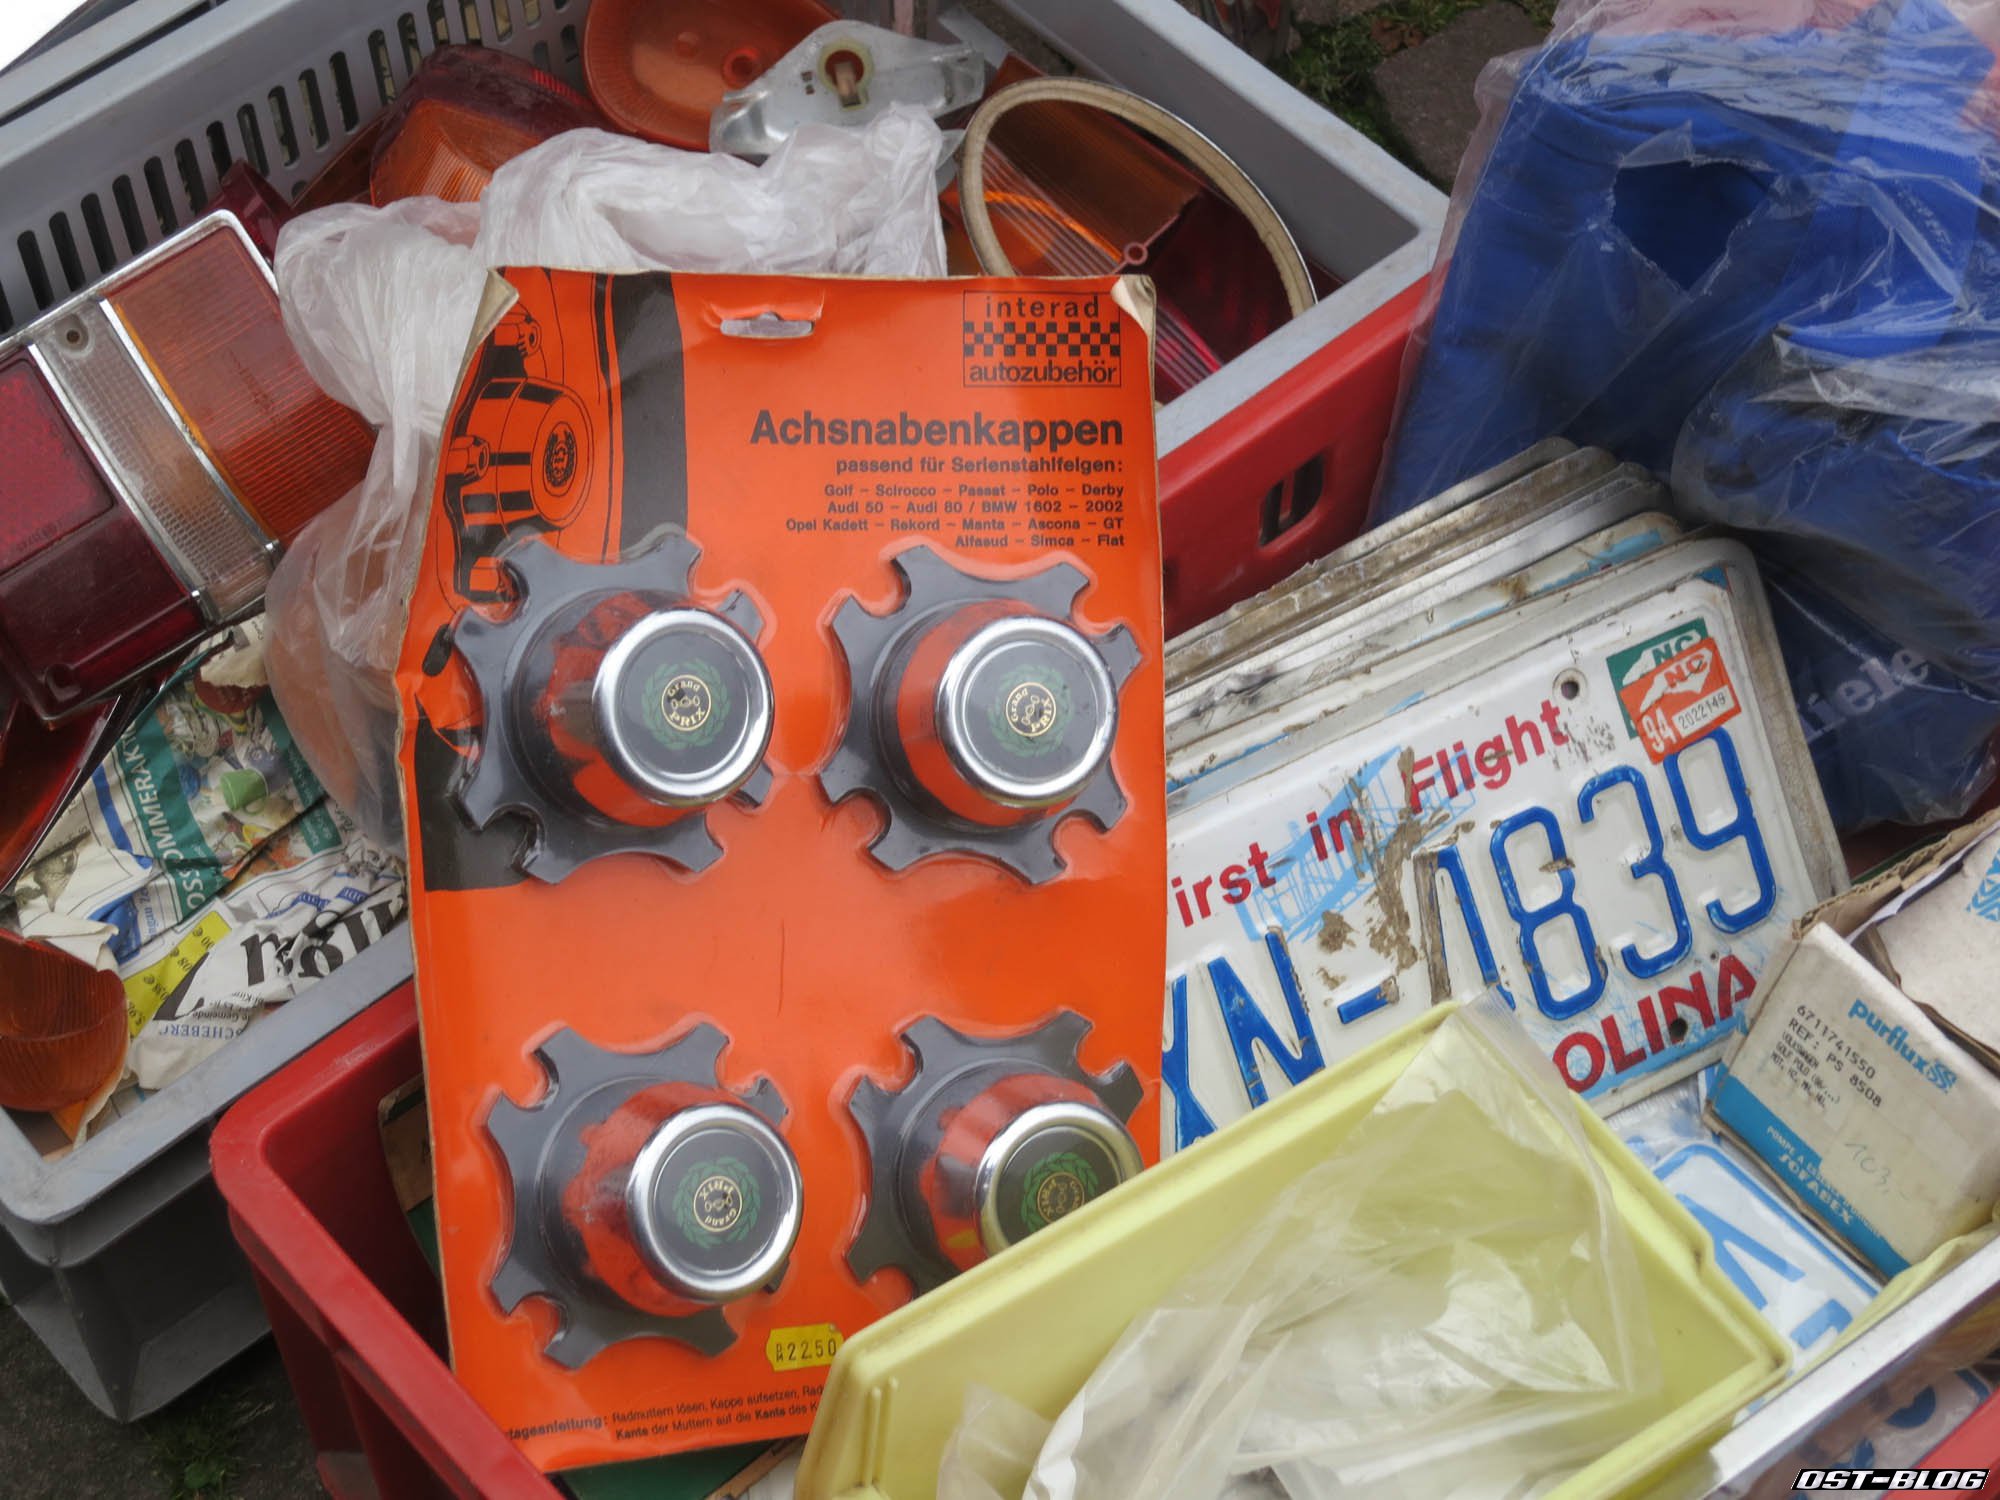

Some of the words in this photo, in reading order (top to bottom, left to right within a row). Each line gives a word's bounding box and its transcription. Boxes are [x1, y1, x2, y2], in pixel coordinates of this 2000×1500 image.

[985, 295, 1100, 318] interad
[969, 359, 1117, 383] autozubehör
[750, 409, 1123, 453] Achsnabenkappen
[836, 456, 913, 475] passend
[920, 455, 945, 473] für
[952, 456, 1123, 476] Serienstahlfelgen:
[824, 484, 853, 497] Golf
[875, 484, 937, 497] Scirocco
[958, 484, 1006, 497] Passat
[1027, 483, 1059, 496] Polo
[1081, 483, 1124, 498] Derby
[827, 501, 859, 514] Audi
[865, 502, 884, 514] 50
[906, 501, 938, 513] Audi
[944, 501, 962, 513] 80
[981, 501, 1018, 513] BMW
[1026, 501, 1062, 513] 1602
[1085, 500, 1123, 513] 2002
[786, 518, 817, 533] Opel
[822, 518, 869, 531] Kadett
[890, 518, 941, 531] Rekord
[962, 518, 1006, 531] Manta
[1028, 518, 1081, 530] Ascona
[1103, 517, 1123, 530] GT
[955, 535, 1008, 548] Alfasud
[1030, 535, 1075, 547] Simca
[1097, 534, 1125, 547] Fiat
[1663, 653, 1708, 689] NC
[1796, 649, 1929, 743] iele
[669, 706, 706, 727] PRIX
[1306, 805, 1366, 864] in
[1401, 698, 1571, 813] Flight
[1796, 1004, 1877, 1080] 6711741550
[1848, 997, 1931, 1076] purflux
[1826, 1053, 1845, 1073] PS
[1848, 1074, 1883, 1108] 8508
[612, 1405, 674, 1423] Radmuttern
[710, 1396, 743, 1410] Kappe
[615, 1426, 649, 1441] Kante
[651, 1422, 669, 1435] der
[672, 1416, 713, 1432] Muttern
[716, 1413, 732, 1425] auf
[736, 1411, 751, 1423] die
[755, 1406, 786, 1420] Kante
[788, 1403, 808, 1416] des
